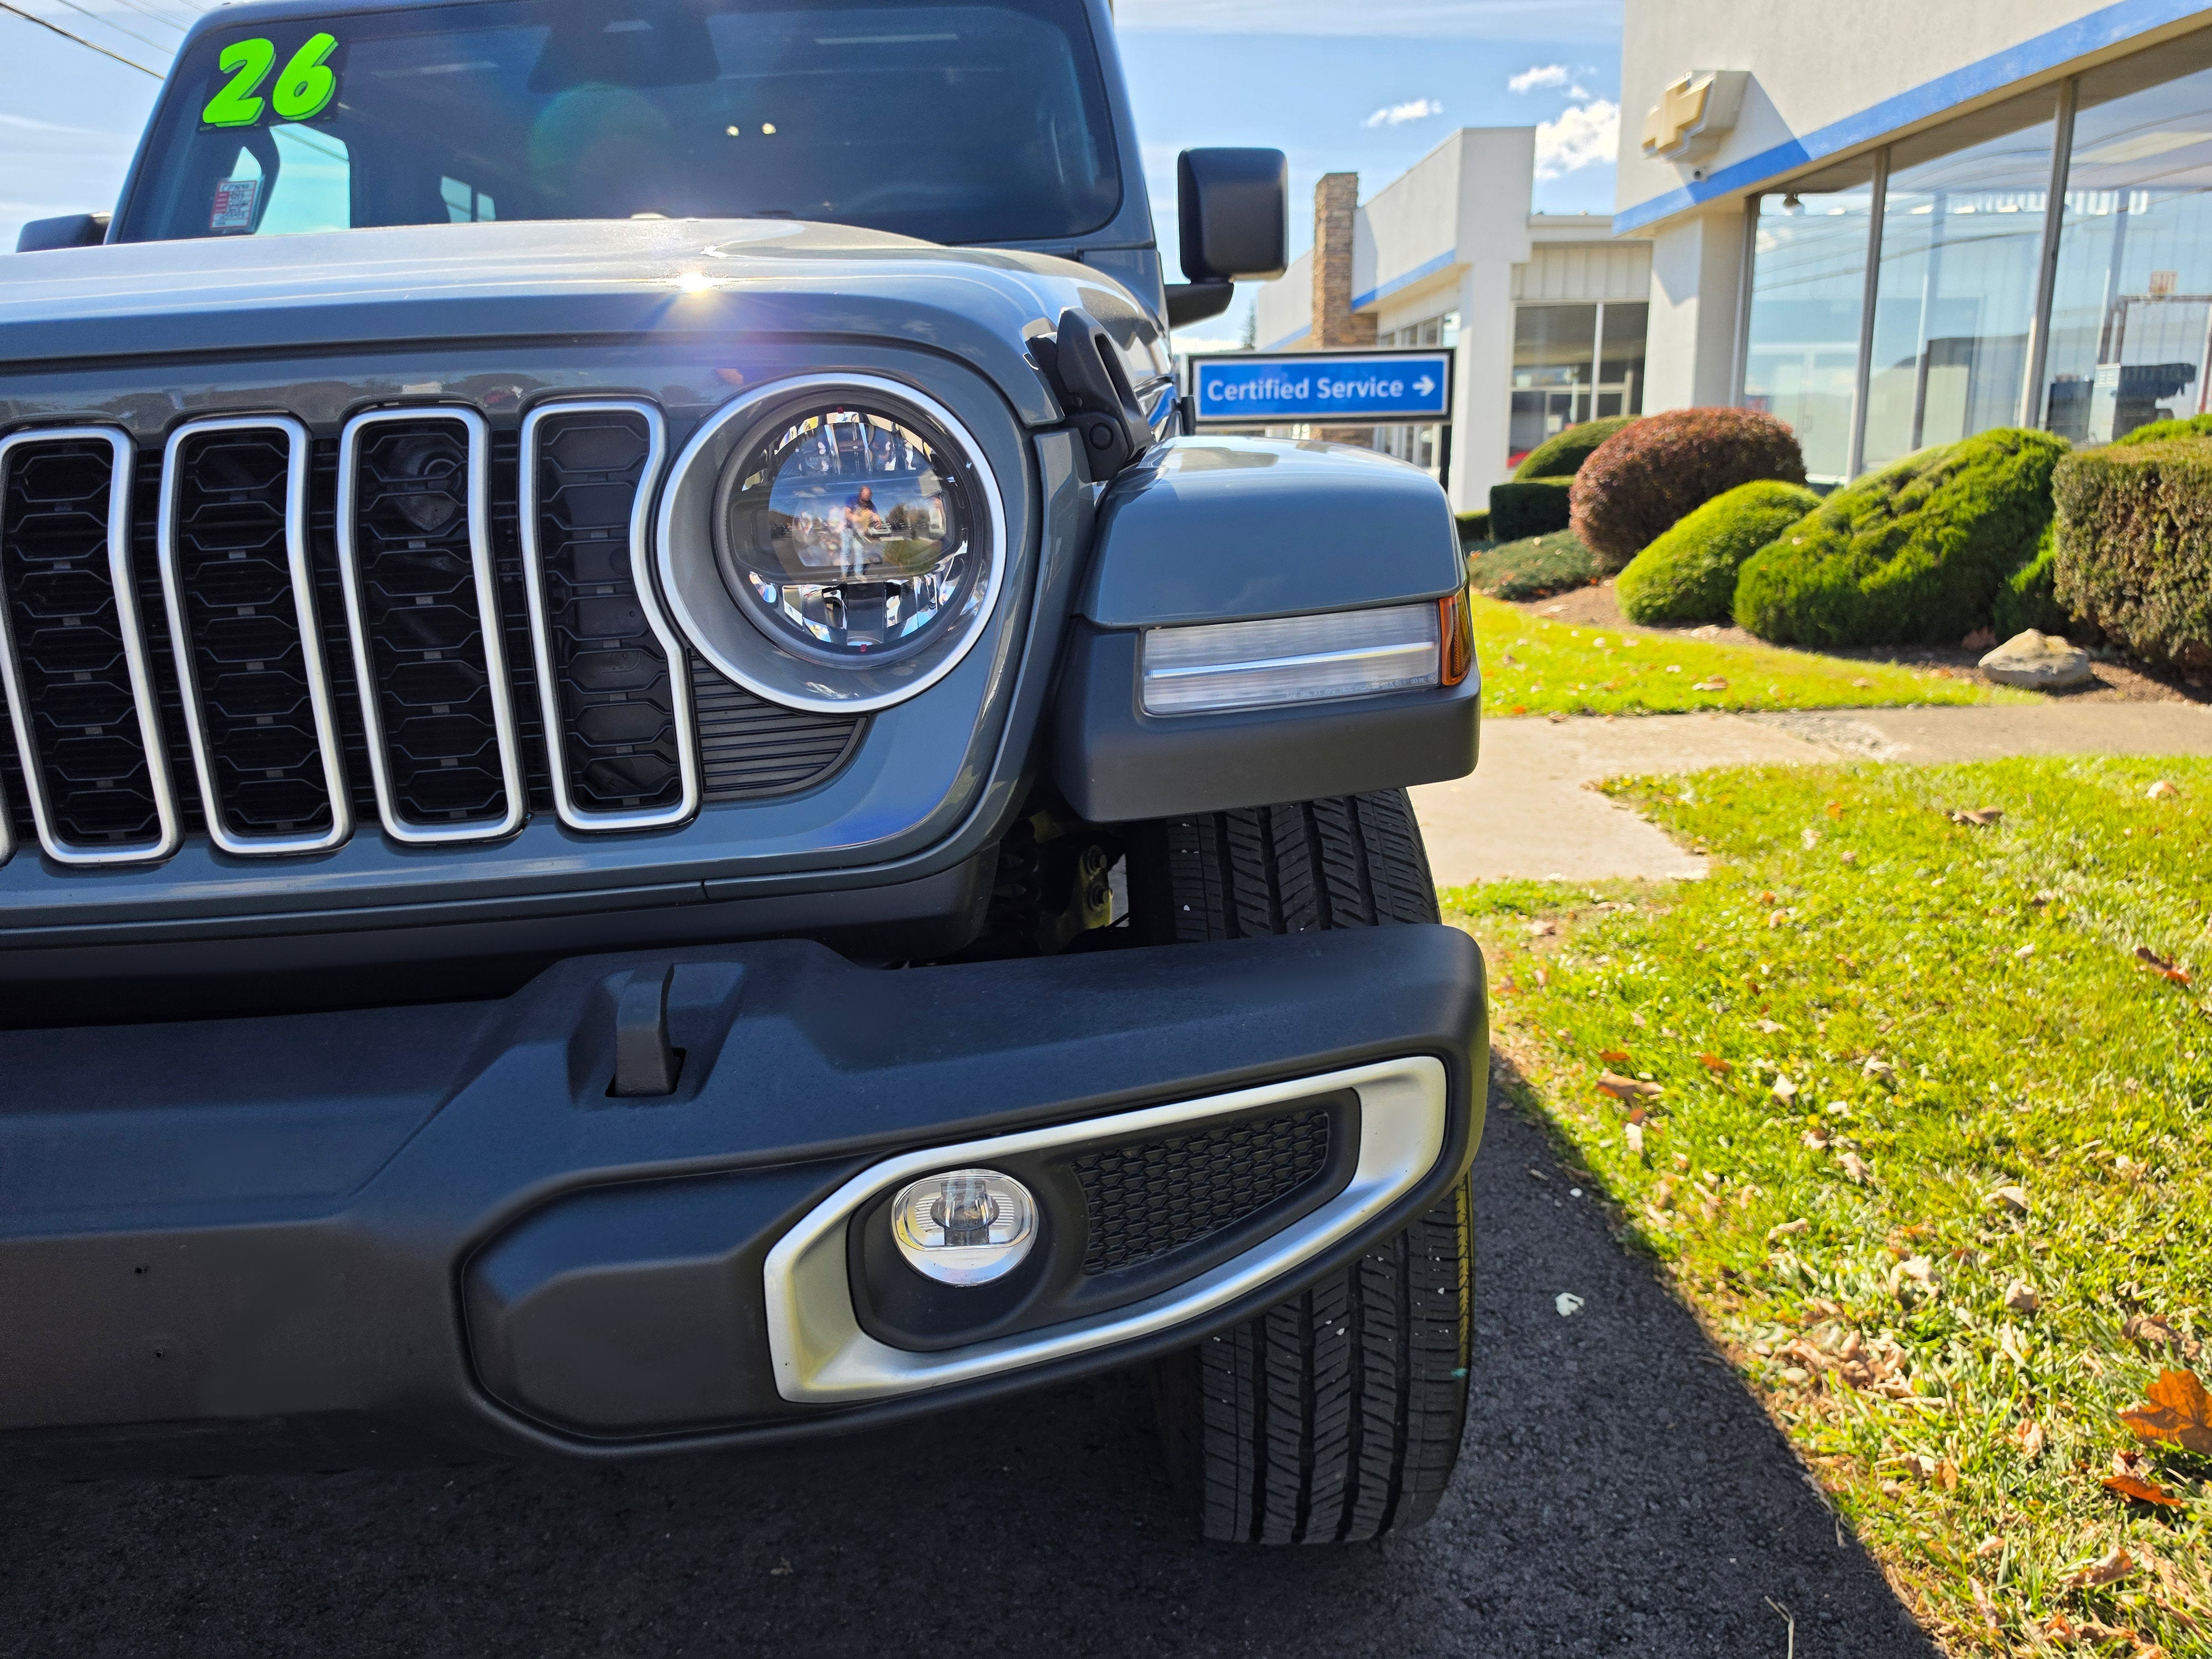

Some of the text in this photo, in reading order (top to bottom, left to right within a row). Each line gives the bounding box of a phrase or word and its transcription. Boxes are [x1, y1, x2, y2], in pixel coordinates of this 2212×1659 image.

[202, 32, 338, 127] 26
[1208, 375, 1404, 401] Certified Service
